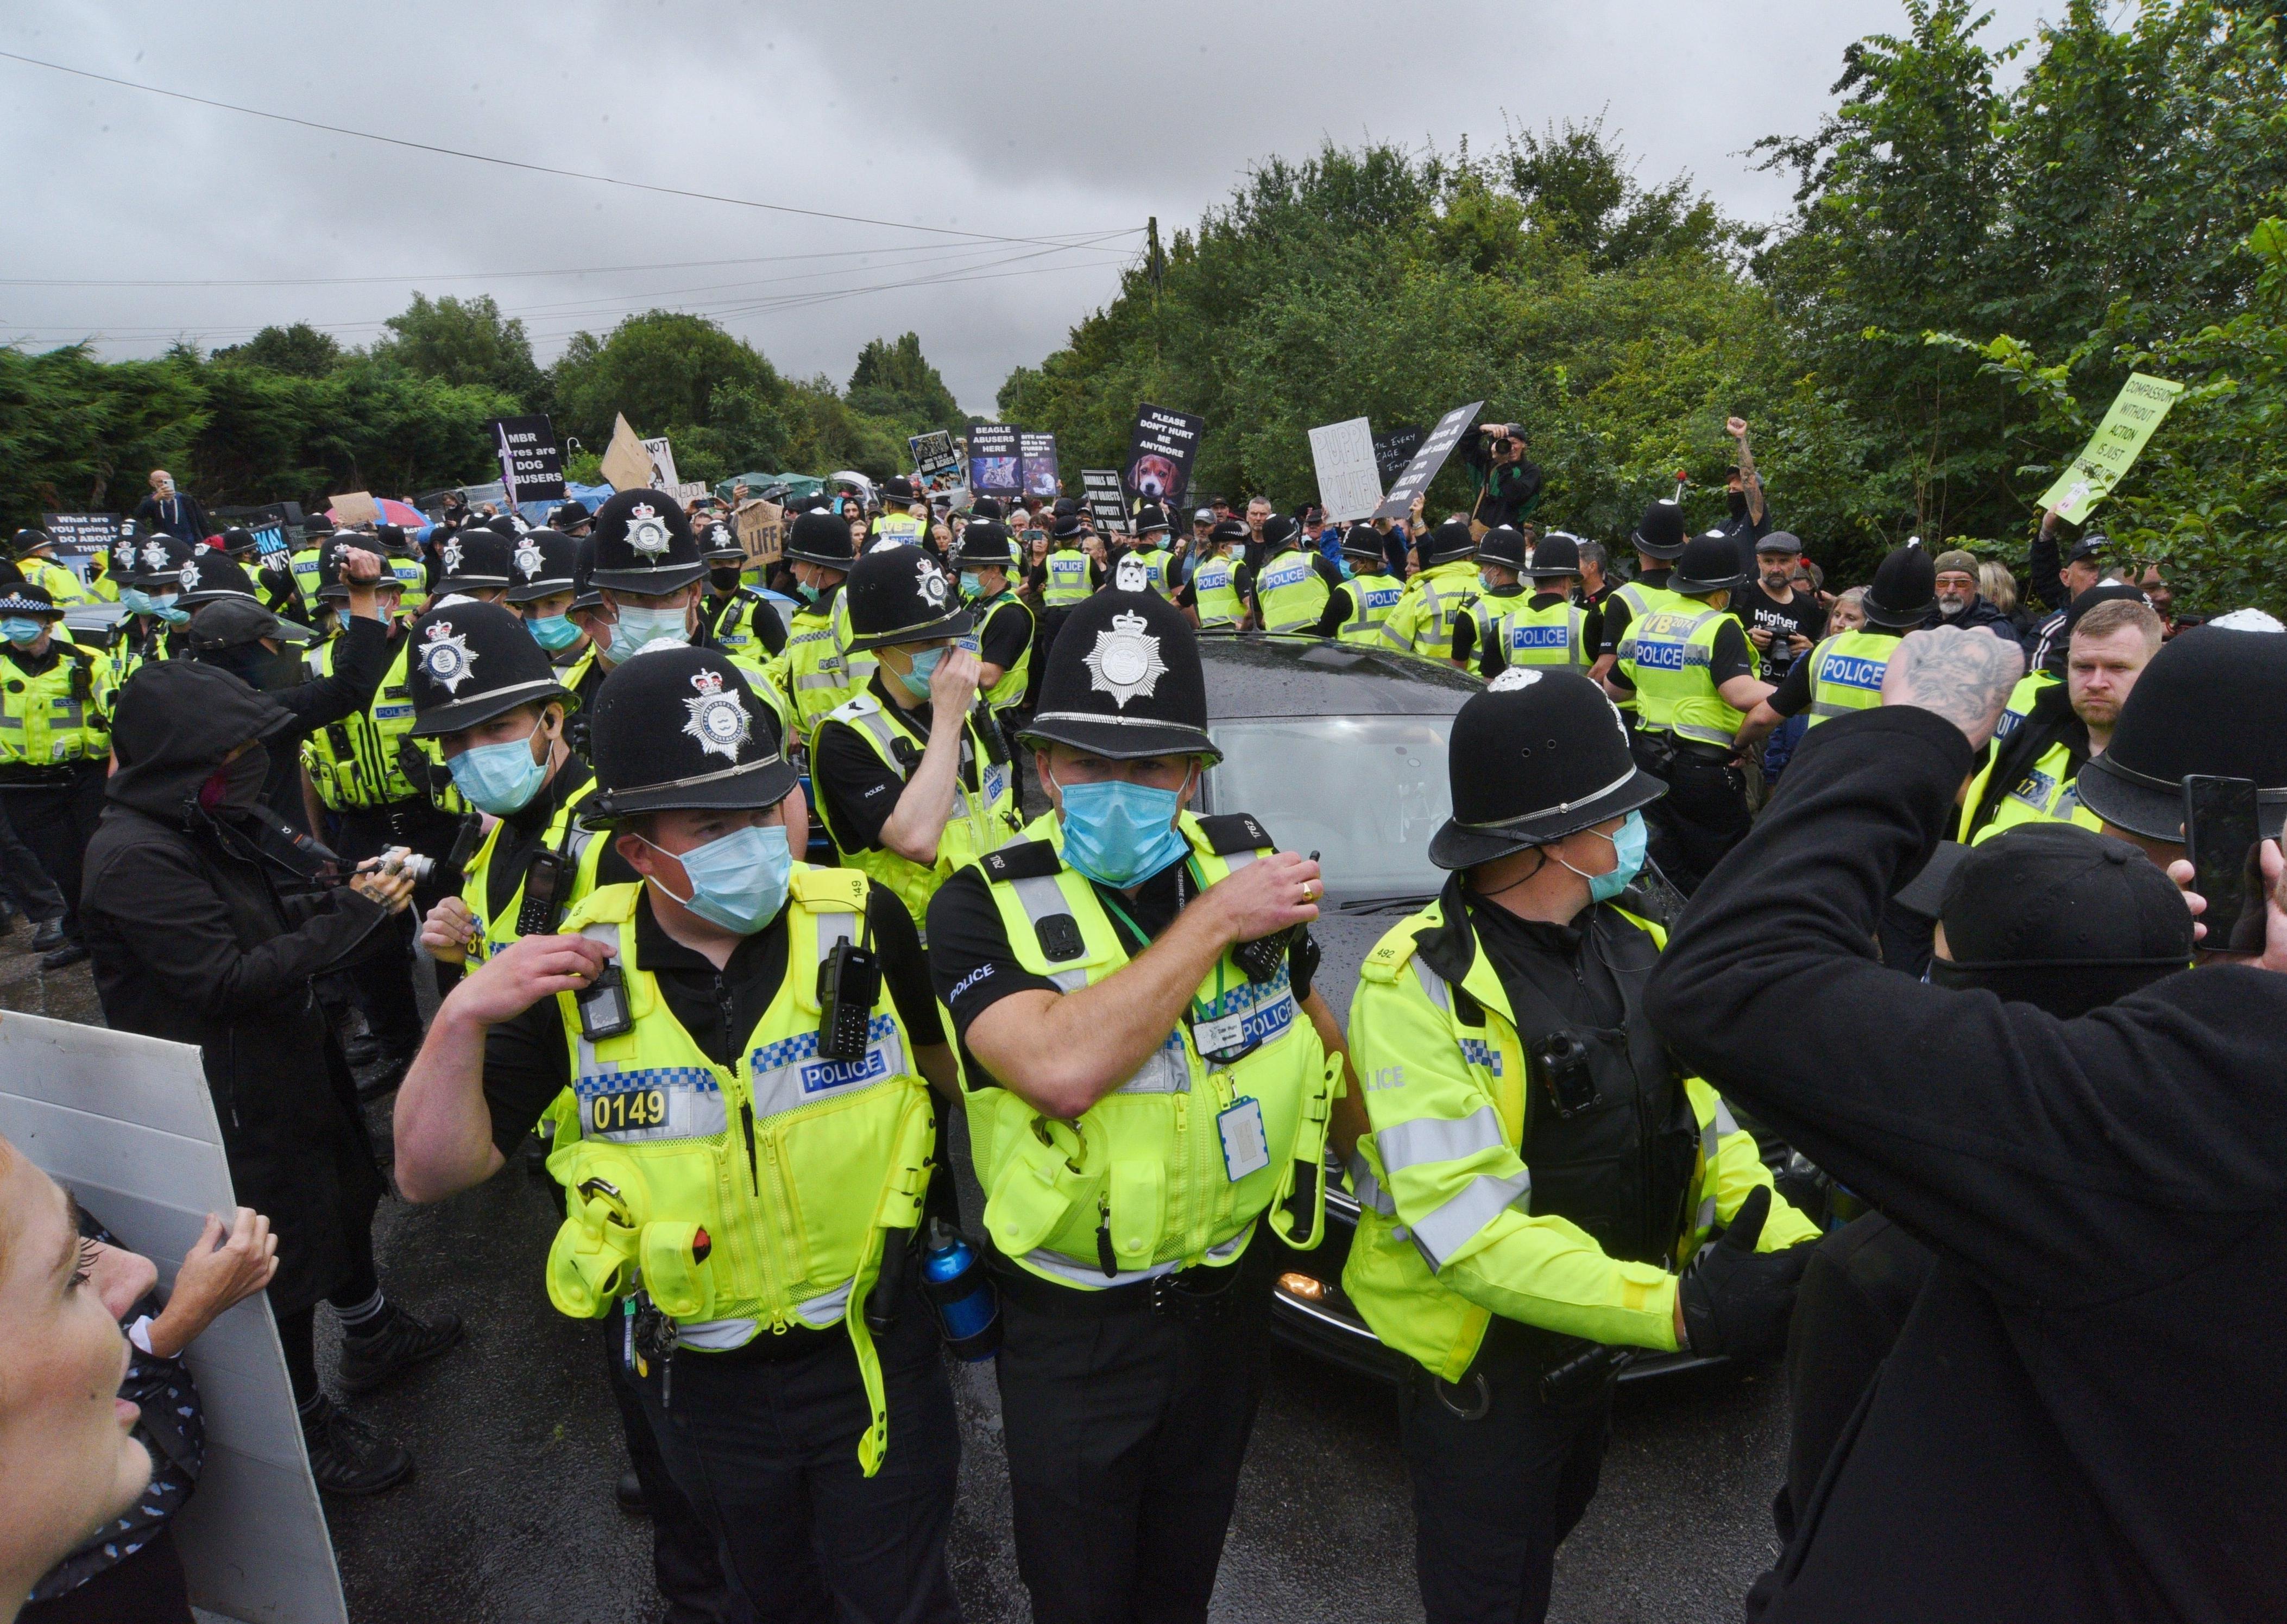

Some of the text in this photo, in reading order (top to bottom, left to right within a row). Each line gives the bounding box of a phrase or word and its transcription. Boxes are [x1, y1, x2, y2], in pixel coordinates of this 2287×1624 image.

[2126, 381, 2172, 403] COMPASSION
[1152, 412, 1186, 427] PLEASE
[2119, 402, 2156, 422] WITHOUT
[1140, 419, 1194, 439] DON'T HURT
[1428, 424, 1460, 443] Acres &
[2108, 423, 2139, 442] ACTION
[508, 433, 537, 443] MBR
[1157, 434, 1171, 444] ME
[1312, 420, 1369, 470] PUPPY
[1391, 433, 1415, 446] EVERY
[498, 447, 556, 458] Ares are
[645, 440, 667, 454] NOT
[1140, 440, 1185, 458] ANYMORE
[1414, 439, 1454, 459] their staff
[2096, 442, 2125, 462] IS JUST
[936, 456, 955, 468] ACRES
[1376, 448, 1399, 463] CAGE
[516, 460, 544, 470] DOG
[1413, 460, 1427, 470] are
[513, 472, 563, 484] BUSERS
[1106, 476, 1118, 486] ARE
[1396, 472, 1427, 488] FILTHY
[1088, 490, 1120, 501] NOT OBJECTS
[1320, 467, 1381, 517] KILLER
[1387, 490, 1412, 503] SCUM
[1094, 505, 1120, 516] PROPERTY
[77, 526, 109, 534] going
[1096, 519, 1105, 529] OR
[749, 525, 778, 556] LIFE
[295, 562, 319, 573] POLICE
[1053, 561, 1083, 571] POLICE
[394, 570, 417, 578] OLICE
[1199, 574, 1225, 587] POLICE
[1267, 568, 1304, 587] POLICE
[1368, 591, 1400, 606] POLIC
[1755, 608, 1798, 630] higher
[1514, 629, 1566, 645] POLICE
[959, 641, 976, 650] POLICE
[1636, 644, 1682, 666] POLICE
[1823, 658, 1886, 686] POLICE
[865, 784, 886, 798] POLICE
[1244, 819, 1262, 839] 1762
[990, 854, 1005, 869] 1762
[852, 880, 864, 898] 149
[1377, 948, 1395, 958] 492
[950, 963, 995, 1004] POLICE
[1243, 1000, 1291, 1042] POLICE
[805, 1054, 881, 1088] POLICE
[1365, 1066, 1406, 1091] LICE
[594, 1090, 665, 1129] 0149
